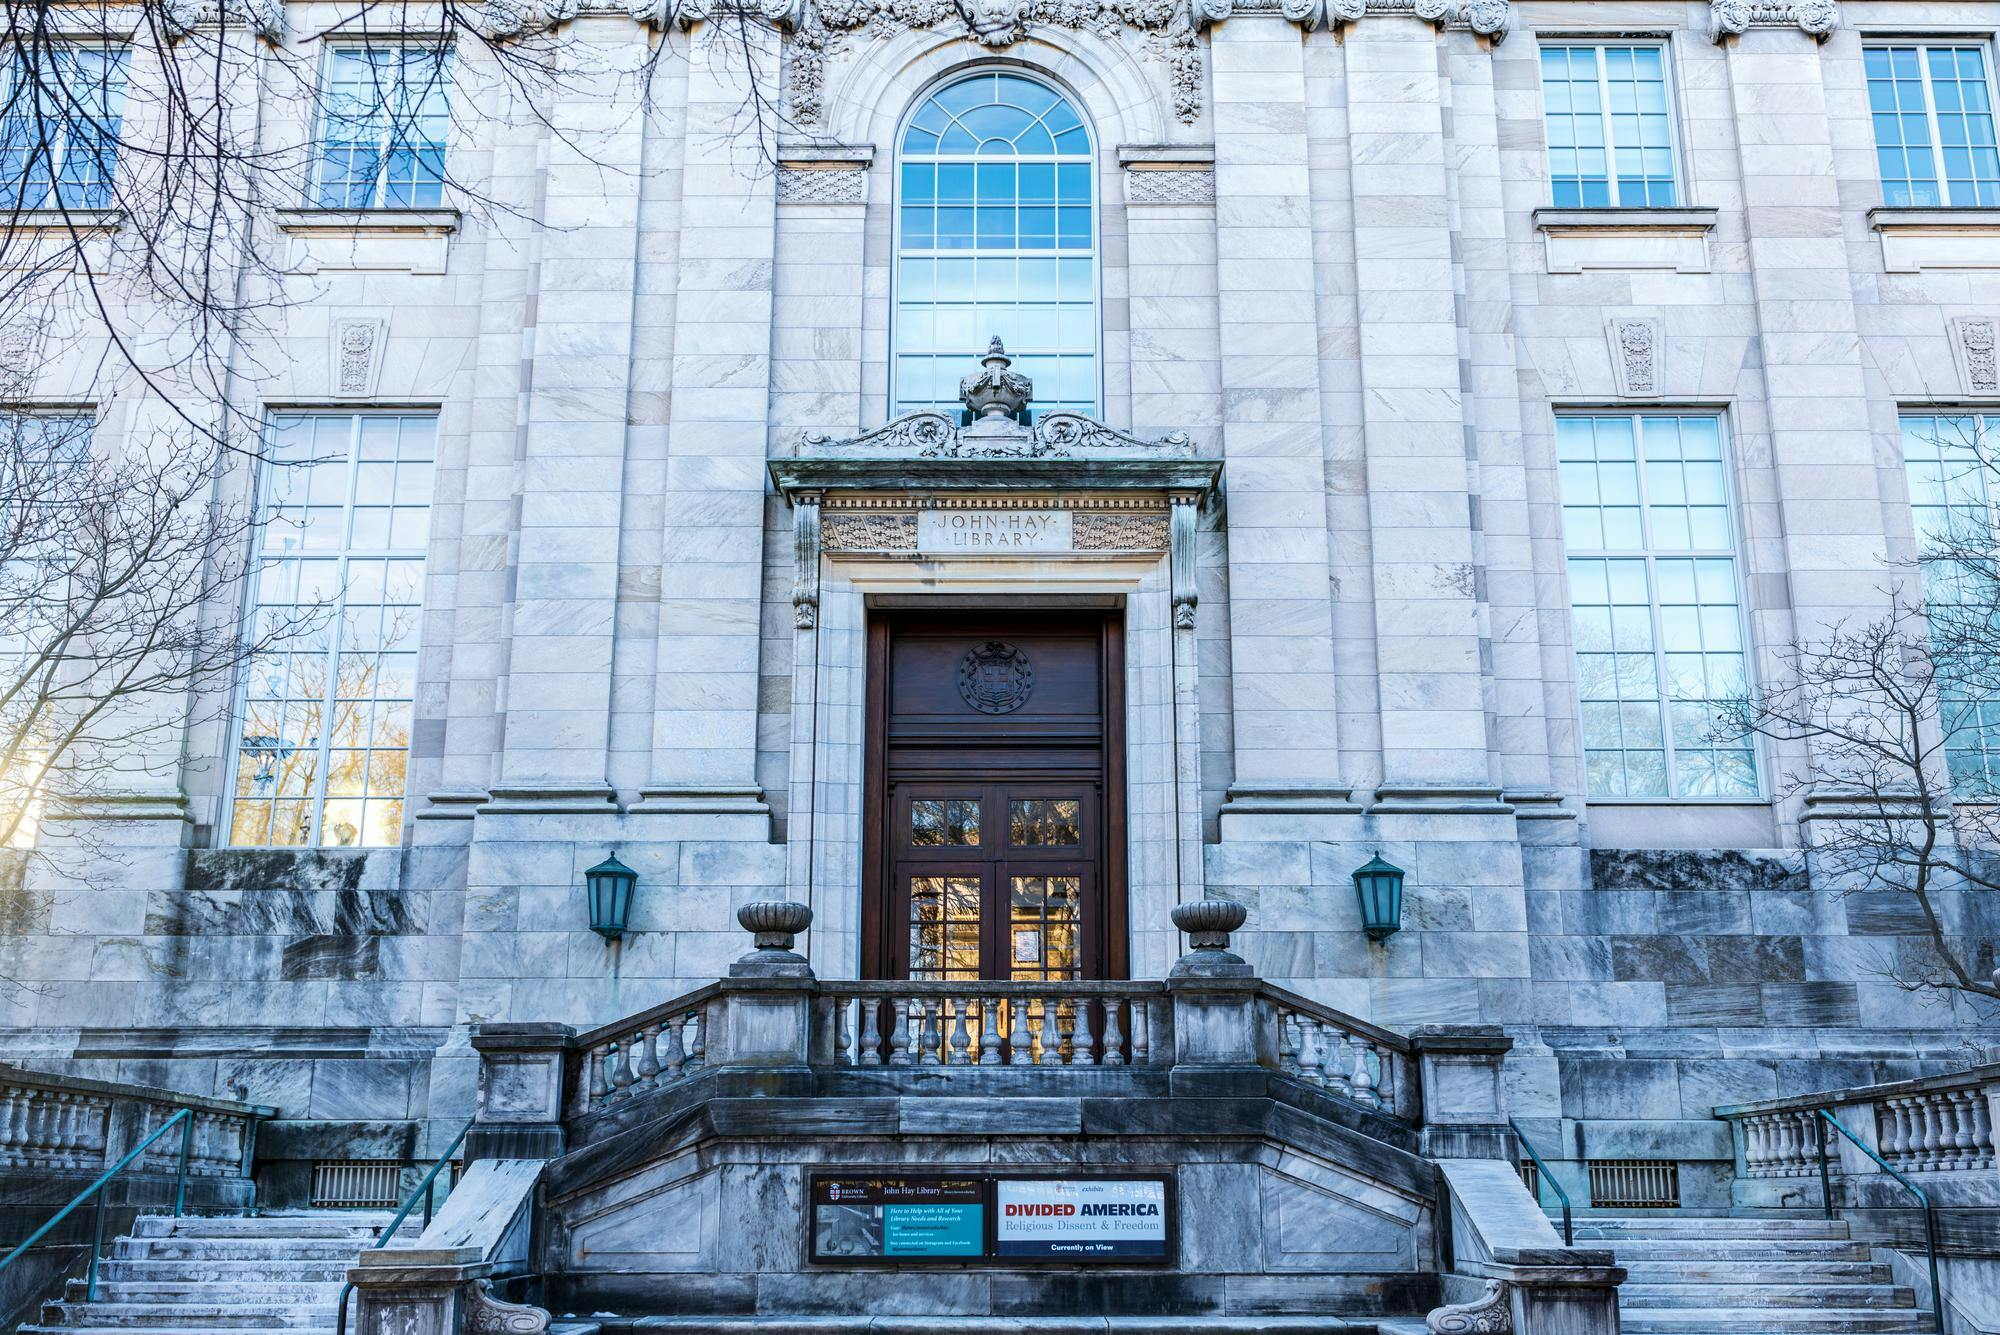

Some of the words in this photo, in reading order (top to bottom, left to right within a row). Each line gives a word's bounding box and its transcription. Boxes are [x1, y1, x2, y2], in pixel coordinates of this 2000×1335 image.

[937, 515, 998, 529] JOHN
[1009, 515, 1051, 529] HAY
[953, 532, 1038, 546] LIBRARY
[884, 1187, 900, 1196] John
[901, 1187, 916, 1196] Hay
[916, 1186, 941, 1197] Library
[910, 1207, 923, 1215] Help
[1005, 1204, 1076, 1217] DIVIDED
[1080, 1203, 1160, 1217] AMERICA
[890, 1215, 910, 1223] Library
[1006, 1220, 1054, 1232] Religious
[1057, 1220, 1097, 1230] Dissent
[1100, 1220, 1110, 1230] &
[1114, 1220, 1160, 1230] Freedom
[1050, 1243, 1084, 1252] Currently
[1095, 1243, 1114, 1251] View
